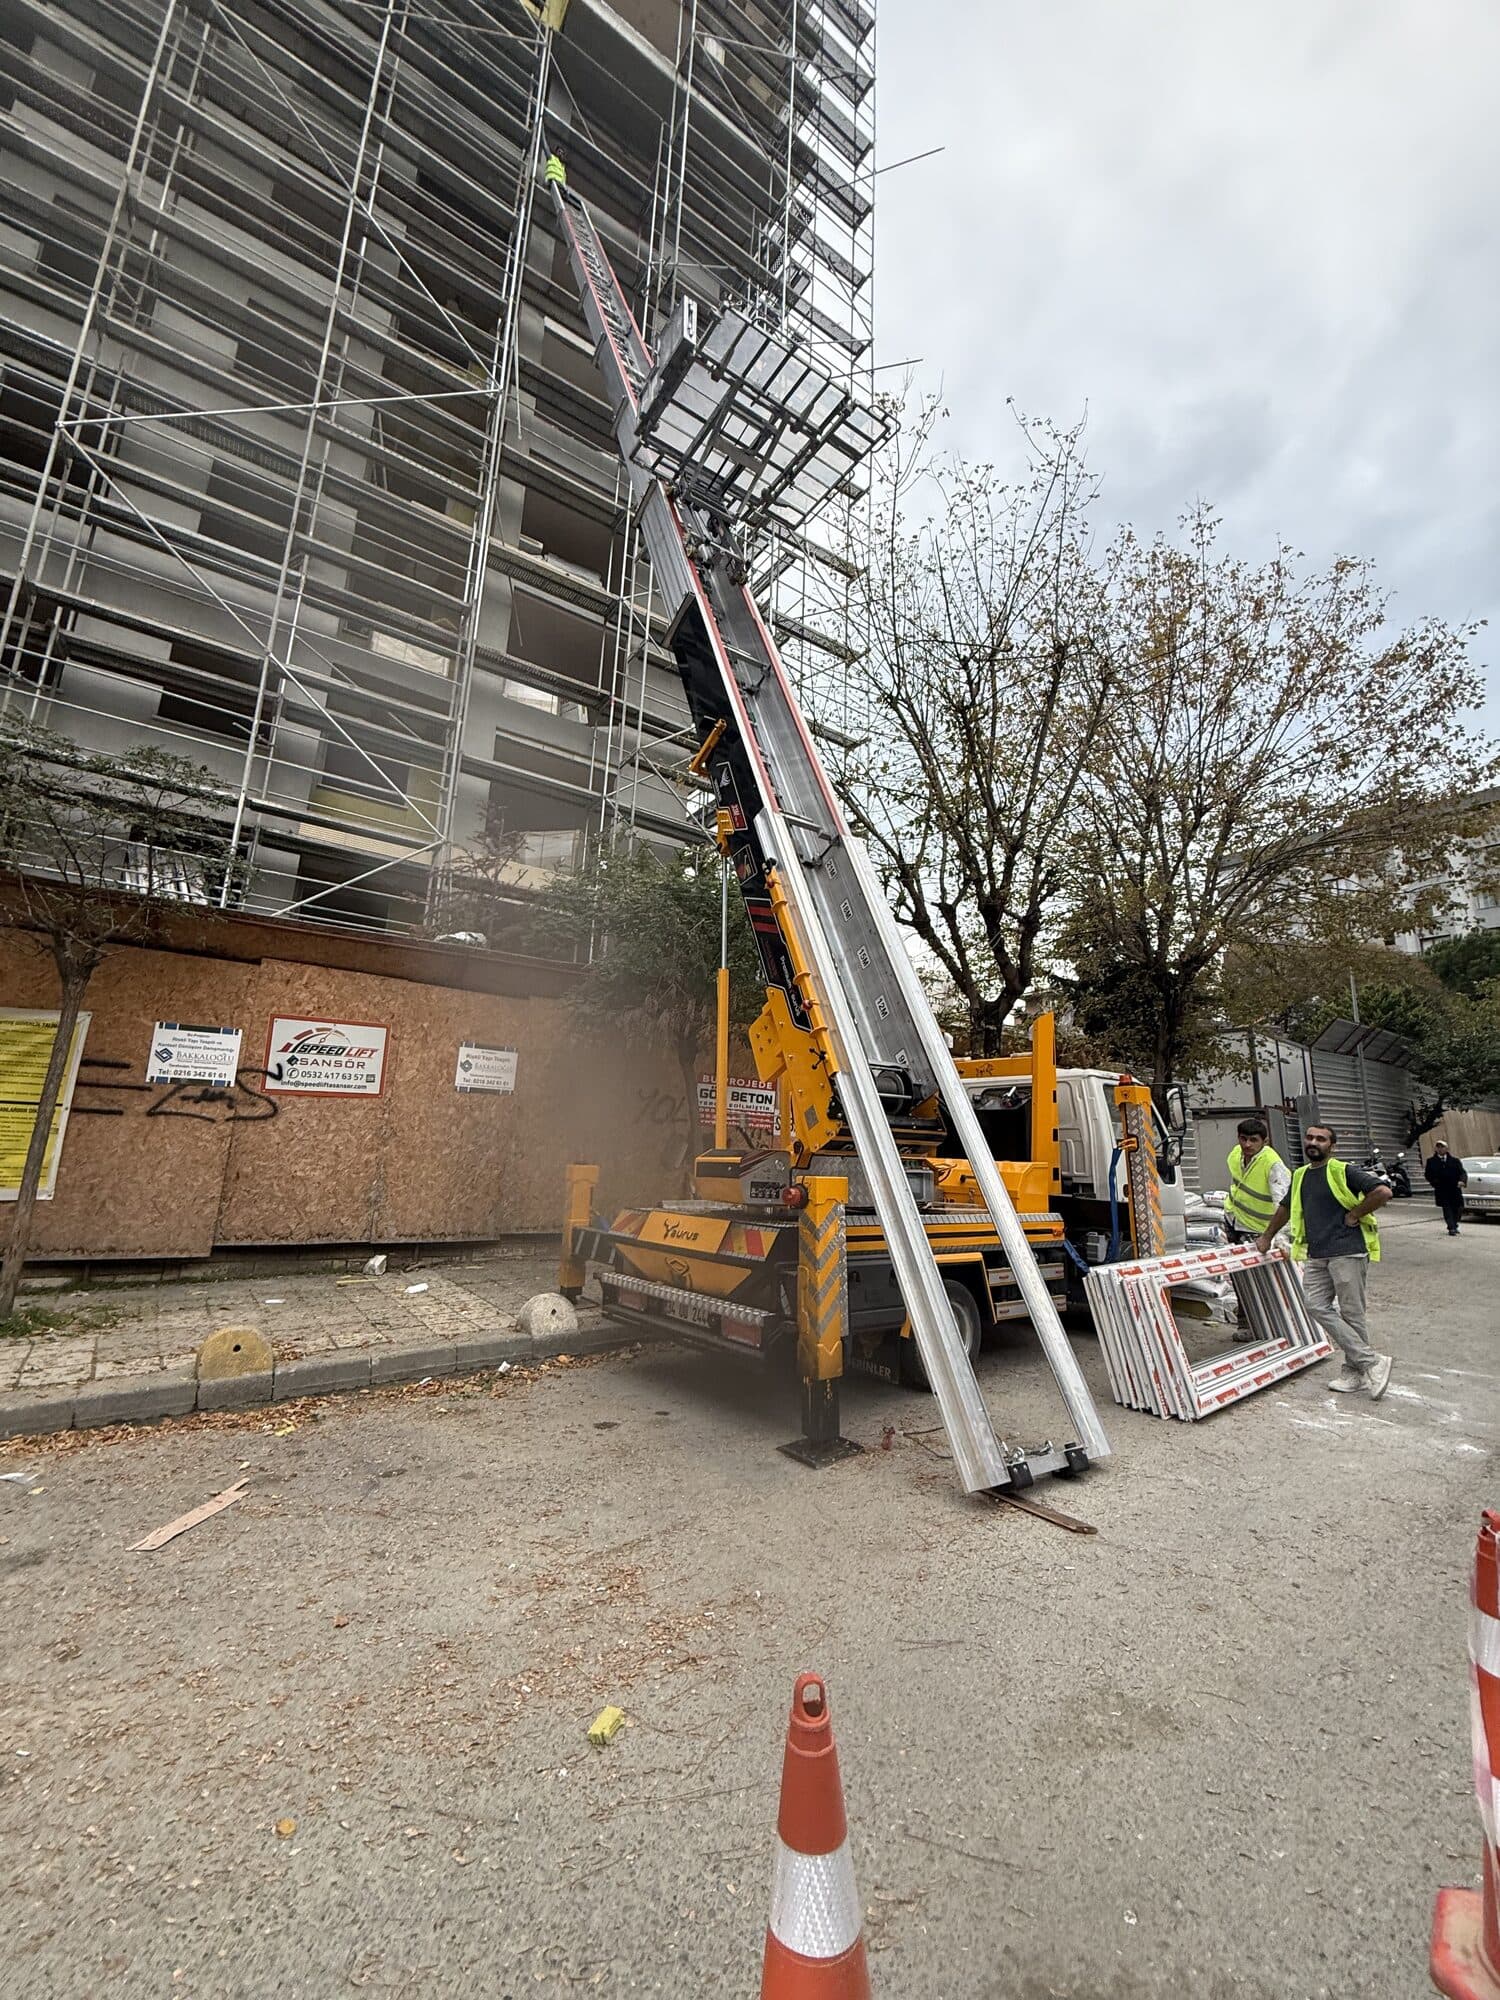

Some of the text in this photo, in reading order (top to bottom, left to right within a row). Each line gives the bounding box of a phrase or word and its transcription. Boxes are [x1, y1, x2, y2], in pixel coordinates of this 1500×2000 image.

[858, 948, 869, 967] 15M
[877, 997, 888, 1018] 12M
[176, 1050, 234, 1061] BAKKALOĞLU
[301, 1070, 364, 1081] 0532 417 63 57
[728, 1077, 773, 1090] ROJEDE
[731, 1091, 773, 1105] BETON
